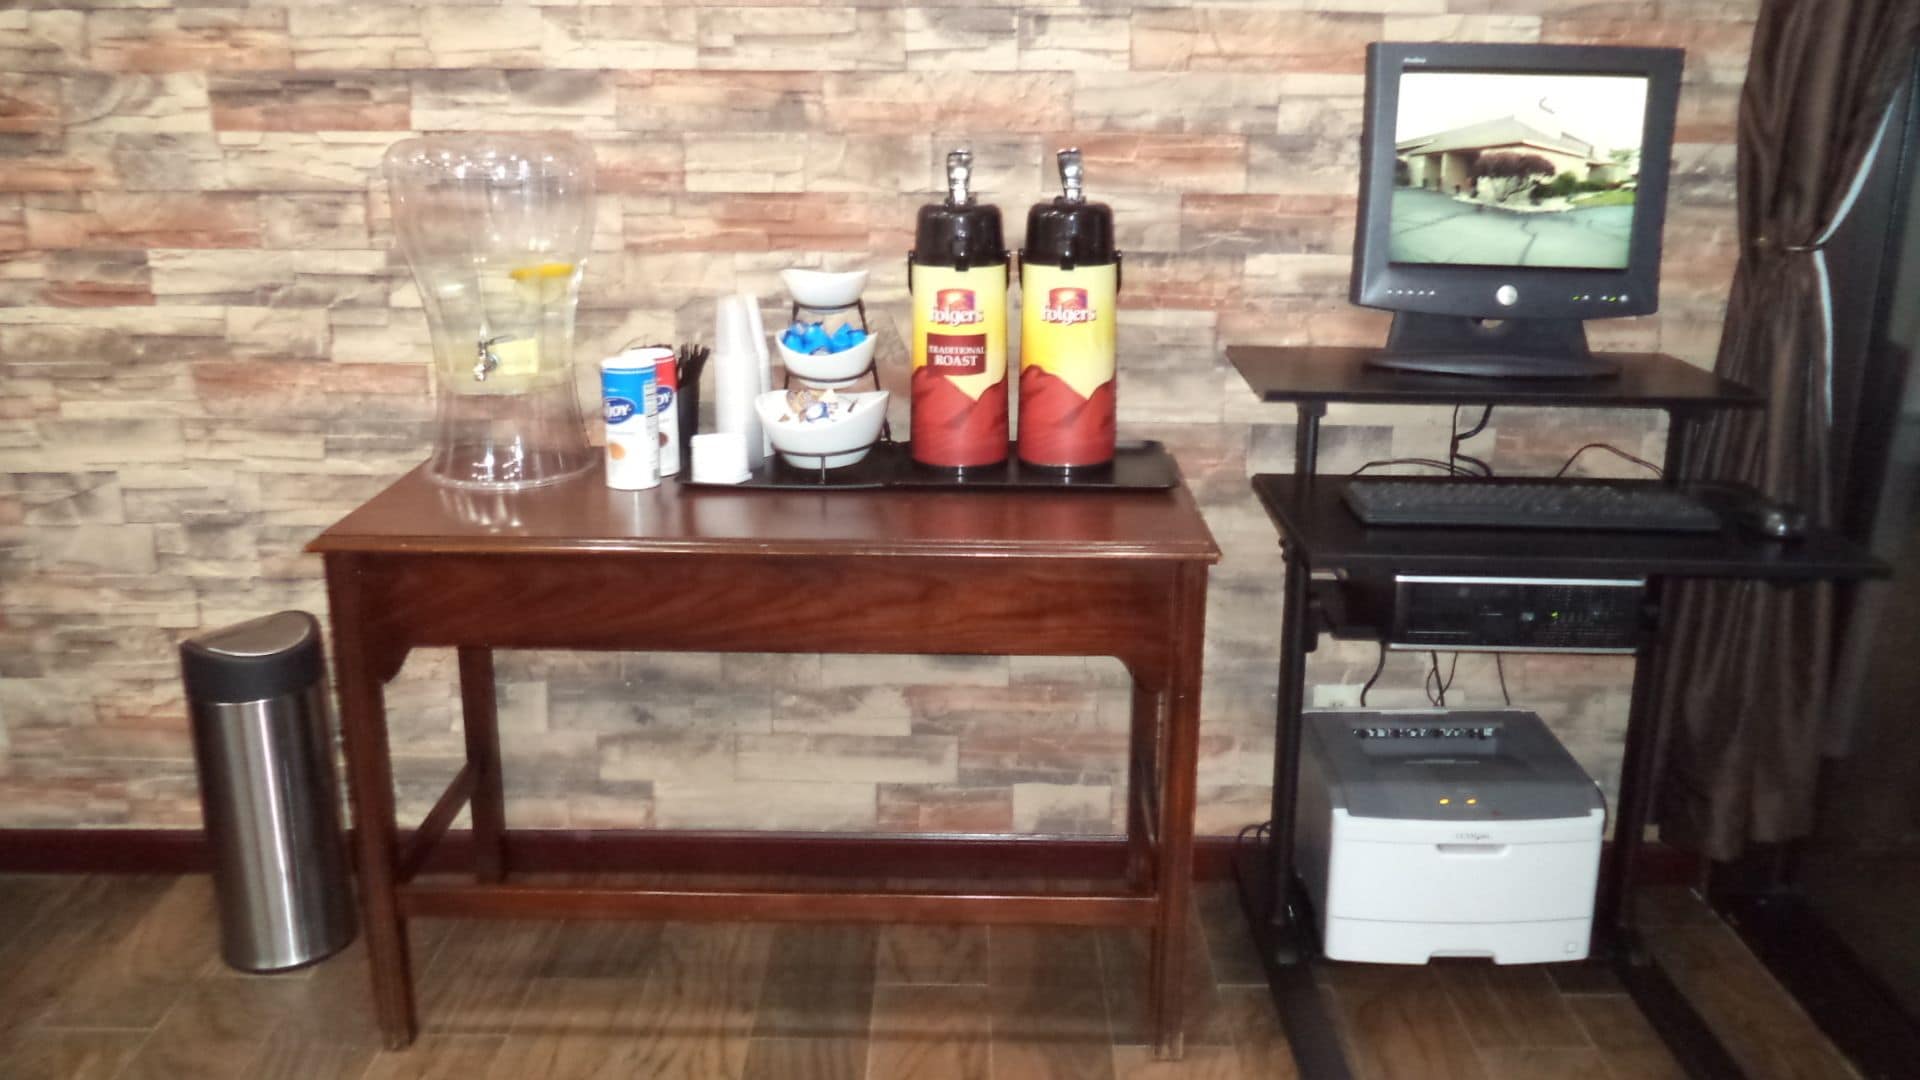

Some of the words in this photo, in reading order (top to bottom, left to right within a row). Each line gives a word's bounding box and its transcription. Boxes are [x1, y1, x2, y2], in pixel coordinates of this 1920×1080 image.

[929, 306, 984, 327] Folgers
[1040, 305, 1096, 326] Folgers
[928, 345, 984, 355] TRADITIONAL
[934, 355, 978, 366] ROAST
